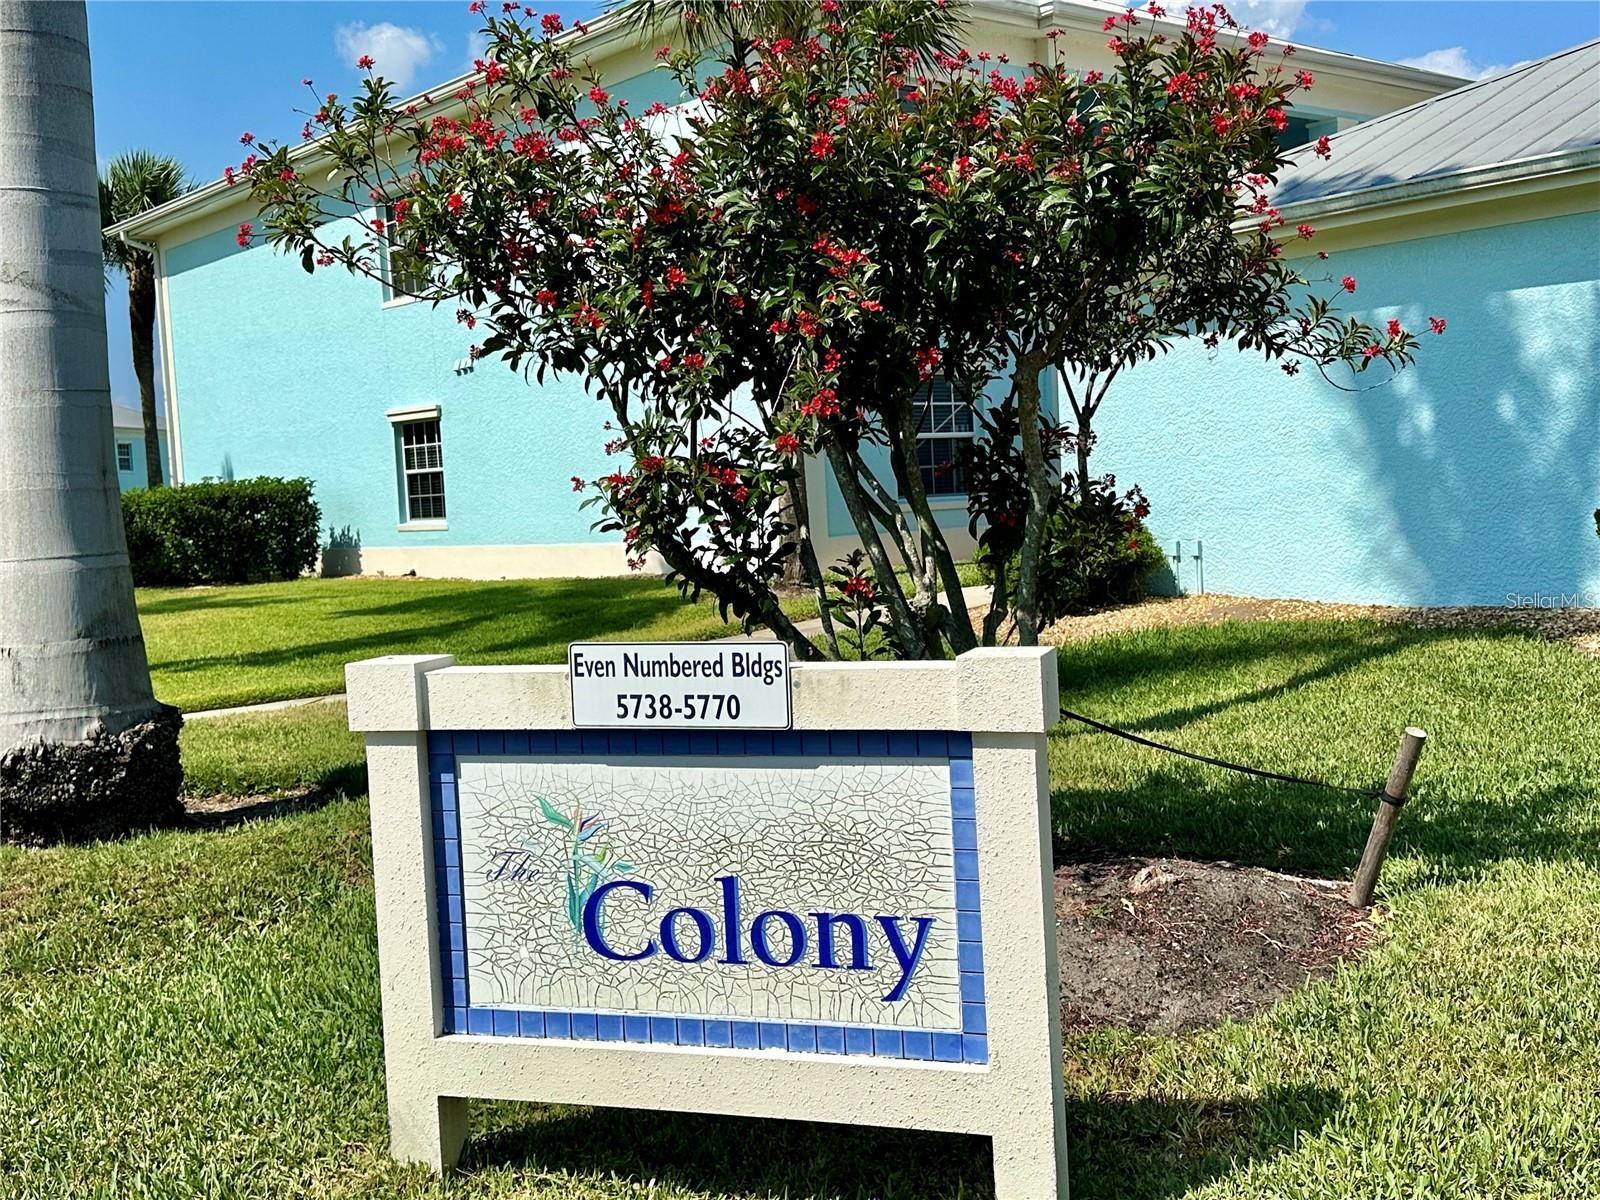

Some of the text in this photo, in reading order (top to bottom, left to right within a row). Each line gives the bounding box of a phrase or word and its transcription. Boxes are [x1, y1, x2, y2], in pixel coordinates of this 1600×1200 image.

[573, 651, 783, 686] Even Numbered Bldgs
[616, 693, 741, 720] 5738-5770
[486, 850, 540, 882] The
[582, 875, 936, 1003] Colony
